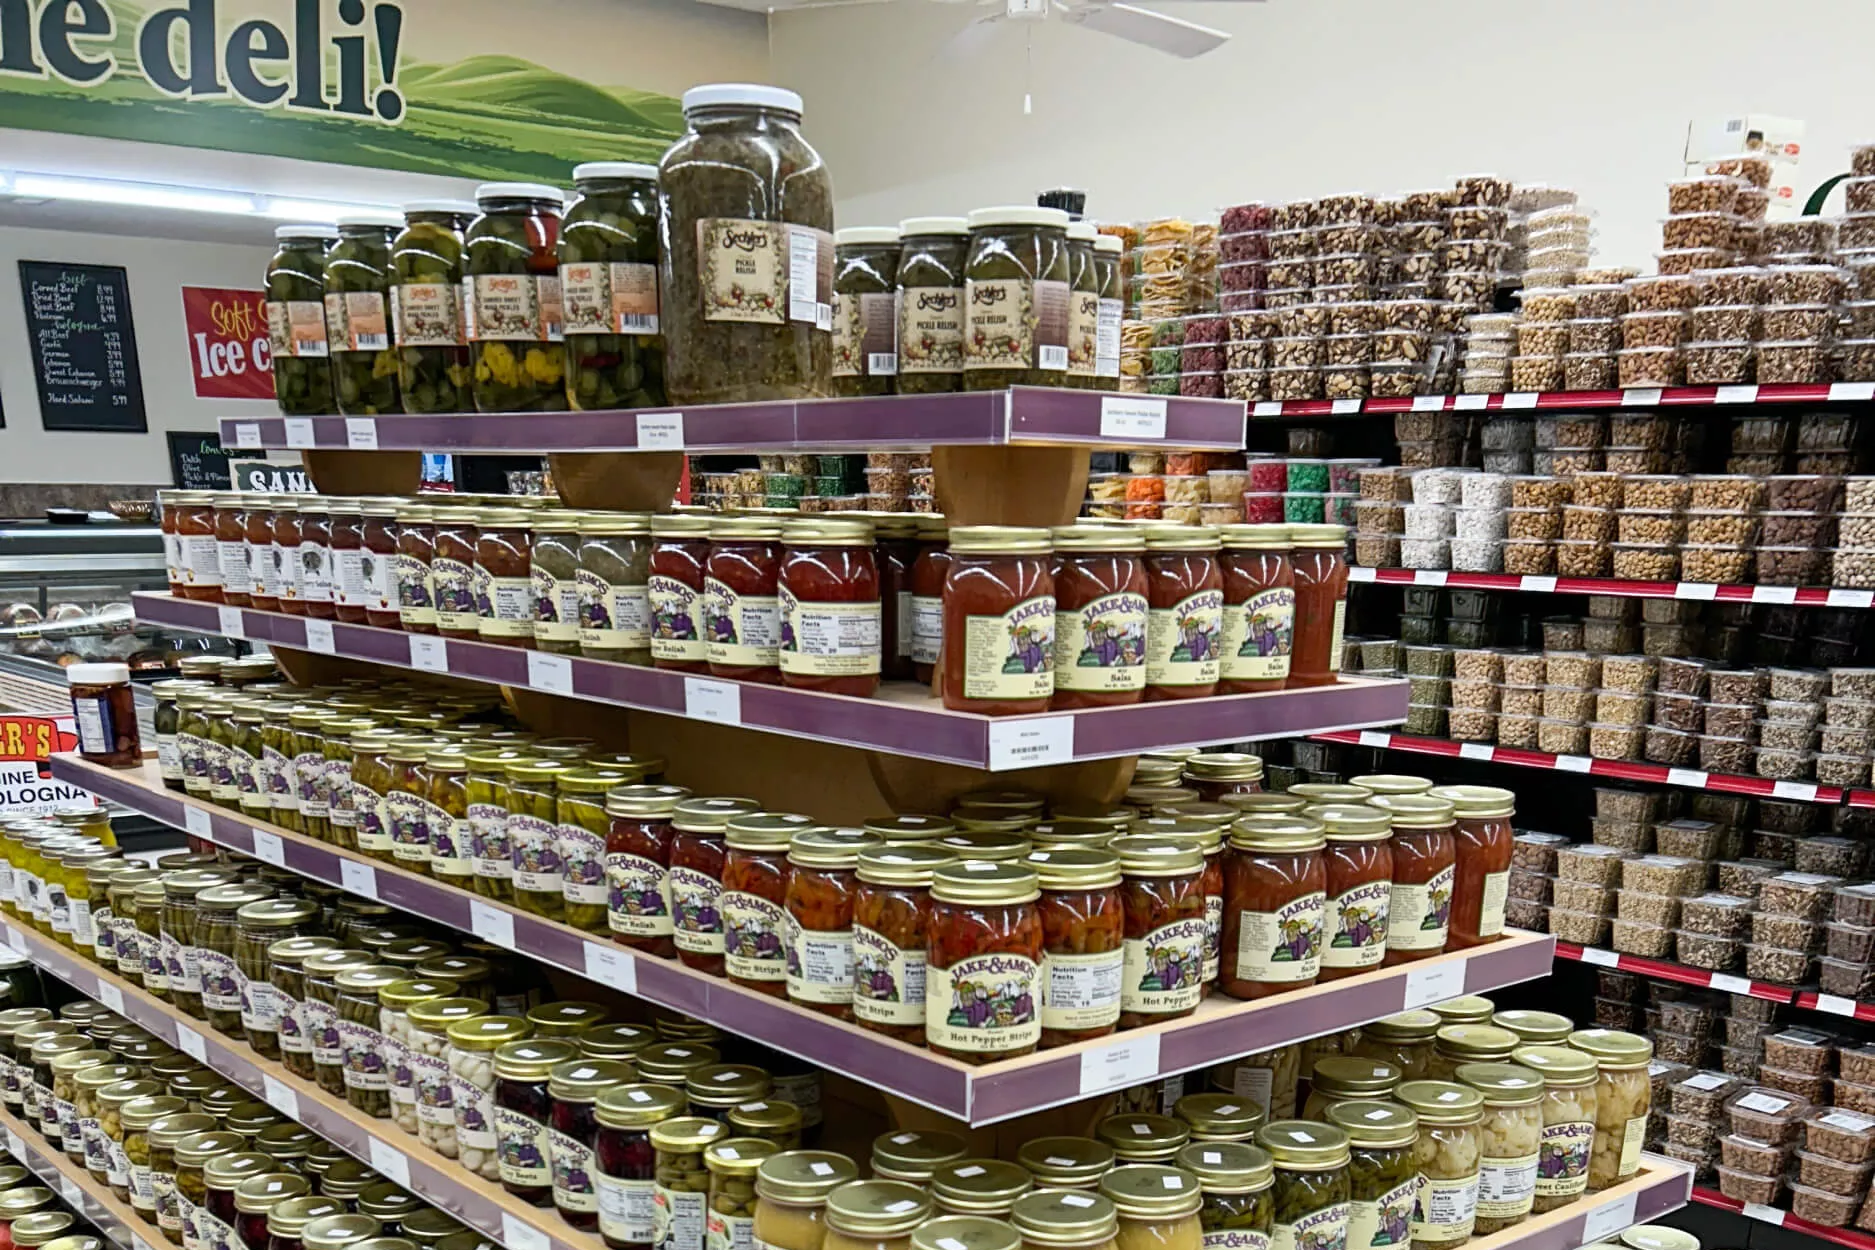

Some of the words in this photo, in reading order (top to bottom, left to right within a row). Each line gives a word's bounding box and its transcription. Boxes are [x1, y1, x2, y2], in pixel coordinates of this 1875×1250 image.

[140, 0, 402, 120] deli!
[211, 300, 256, 341] Soft
[194, 333, 246, 378] Ice
[1110, 674, 1131, 683] Salsa
[1142, 997, 1161, 1005] Hot
[950, 1033, 968, 1042] Hot
[971, 1035, 1006, 1047] Pepper
[1009, 1031, 1033, 1042] Strips
